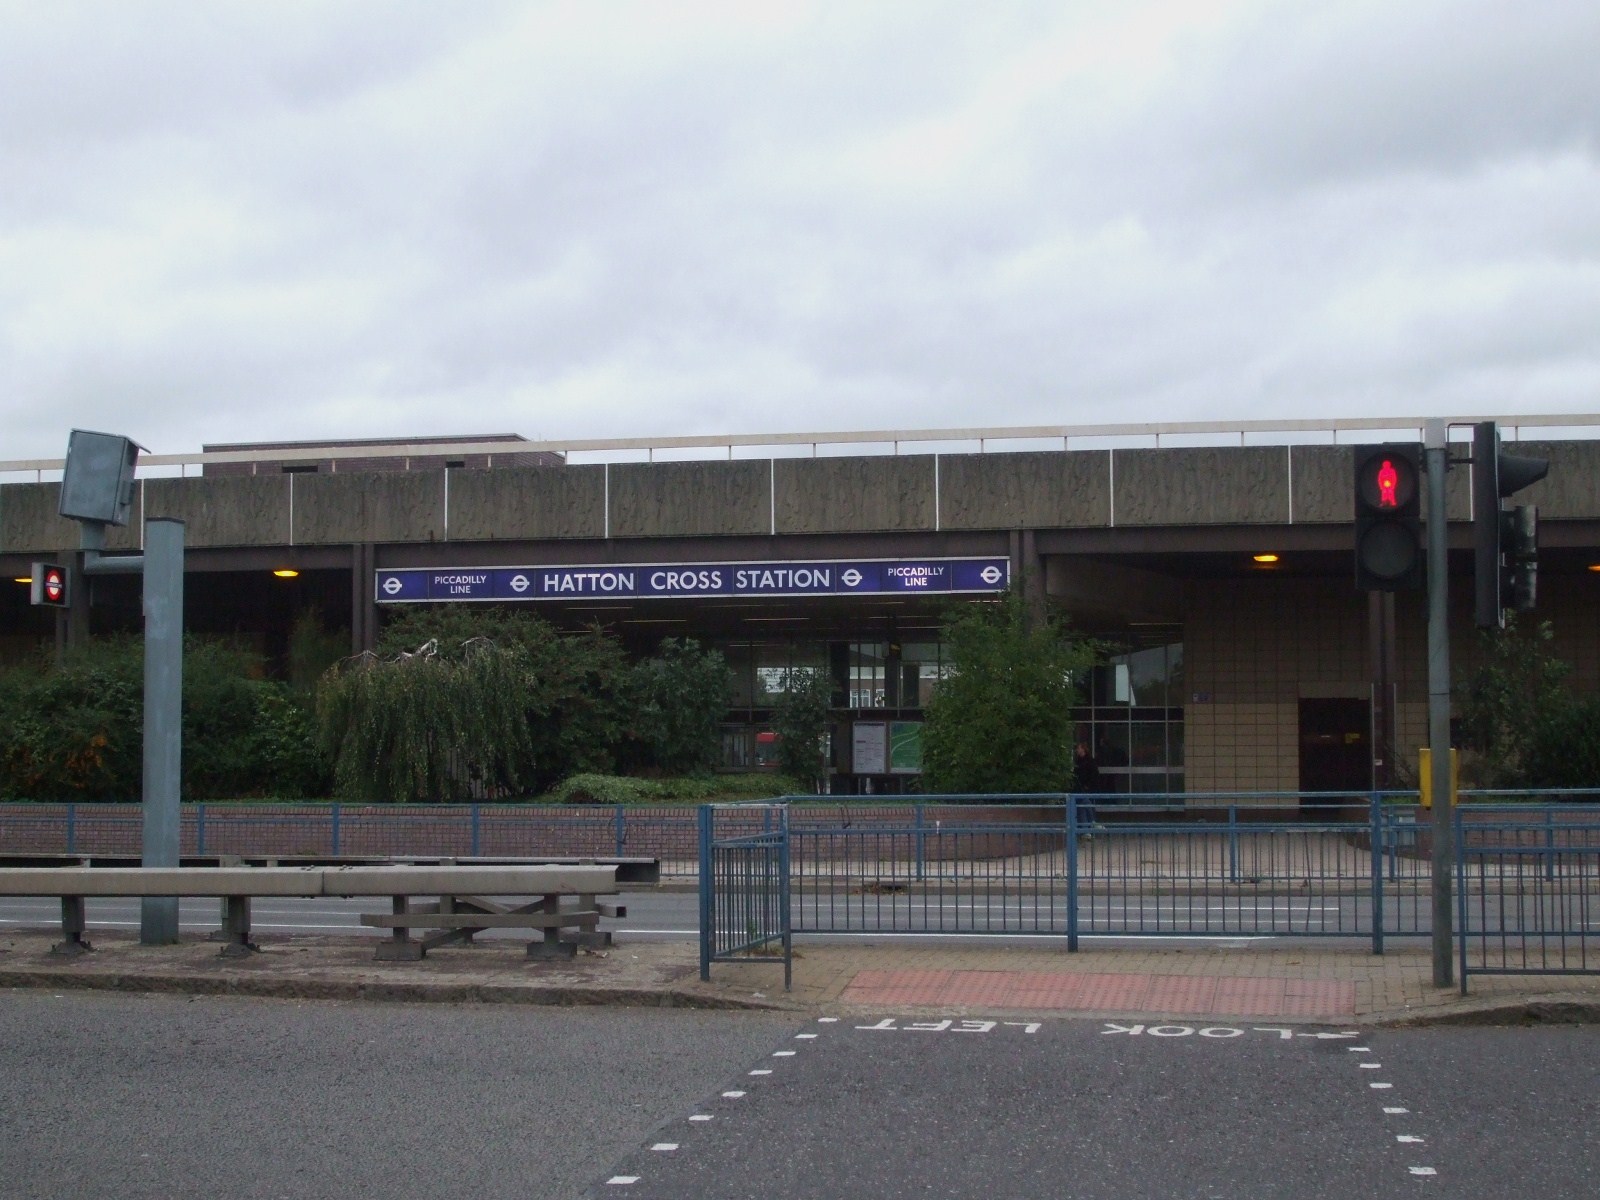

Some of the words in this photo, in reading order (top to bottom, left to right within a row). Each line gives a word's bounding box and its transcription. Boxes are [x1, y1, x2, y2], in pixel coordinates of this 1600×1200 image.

[888, 567, 944, 577] PICCADILLY
[434, 575, 487, 584] PICCADILLY
[544, 573, 634, 592] HATTON
[650, 571, 722, 590] CROSS
[735, 569, 830, 589] STATION
[904, 577, 928, 586] LINE
[450, 585, 471, 594] LINE
[855, 1018, 1042, 1034] LEFT
[1101, 1023, 1292, 1040] LOOK
